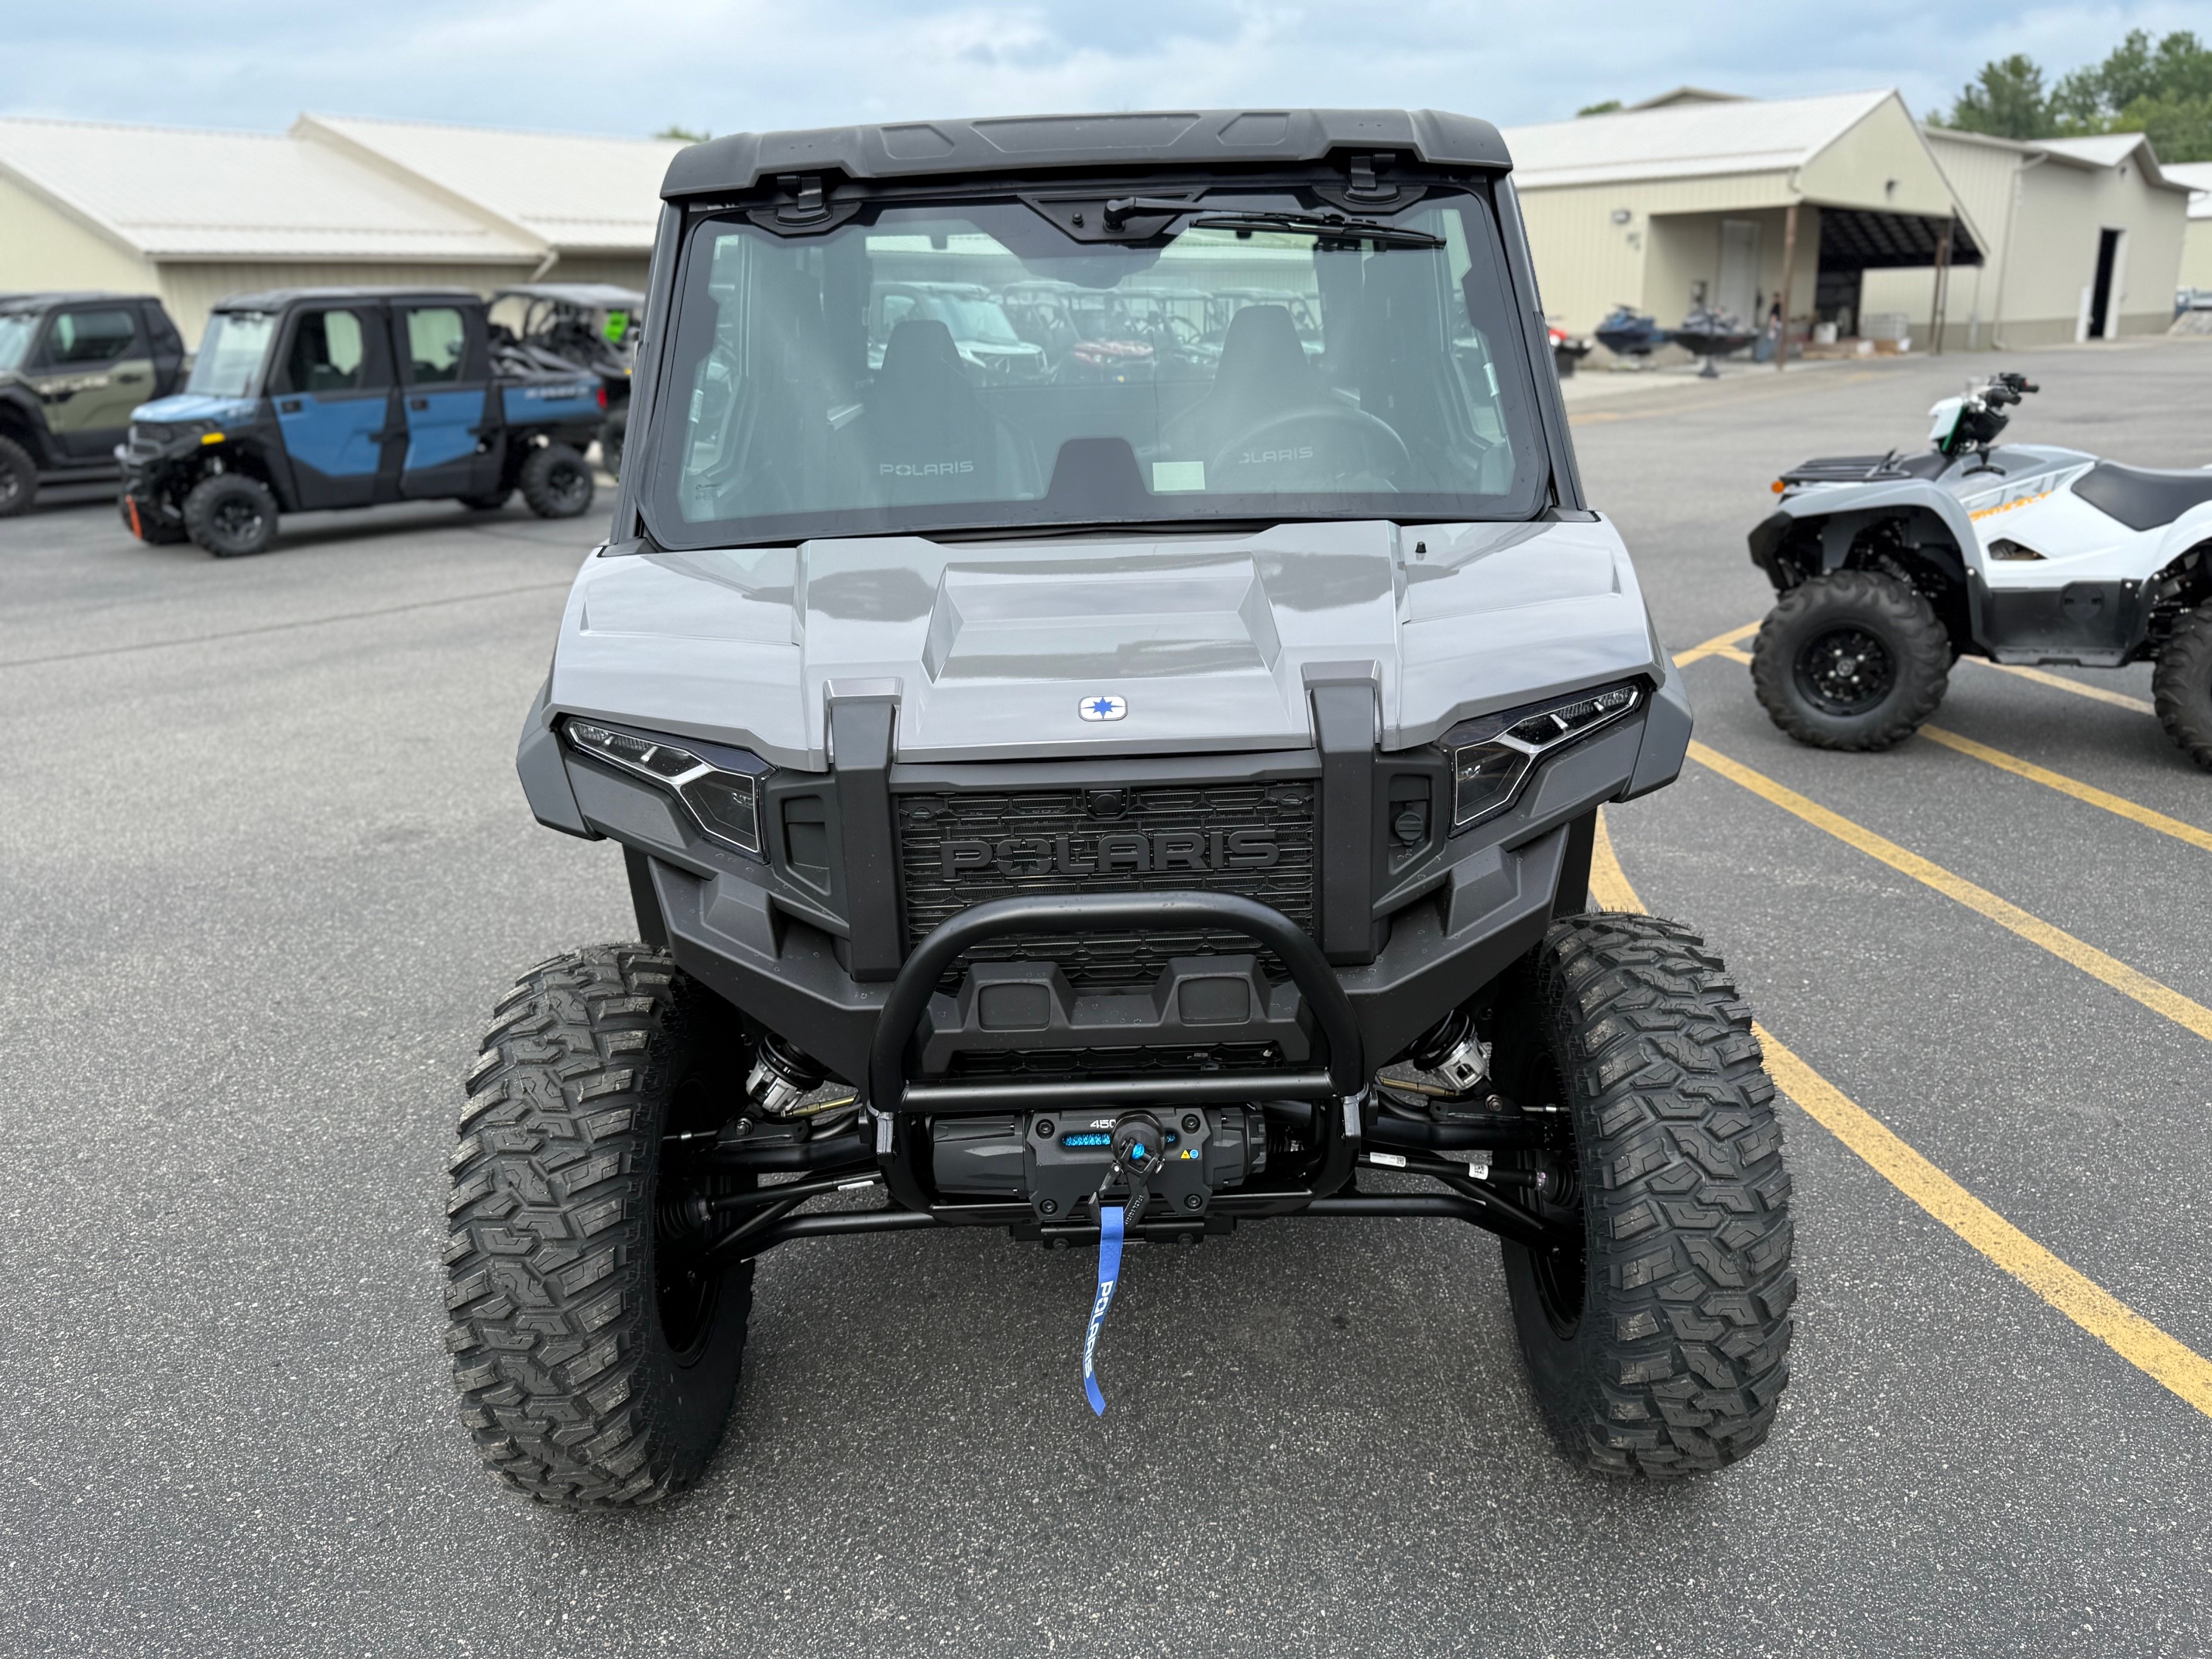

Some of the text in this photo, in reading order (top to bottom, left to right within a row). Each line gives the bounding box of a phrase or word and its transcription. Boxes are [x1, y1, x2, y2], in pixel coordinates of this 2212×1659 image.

[880, 460, 974, 476] POLARIS
[940, 829, 1280, 881] POLARIS
[1084, 1280, 1114, 1379] POLARIS
